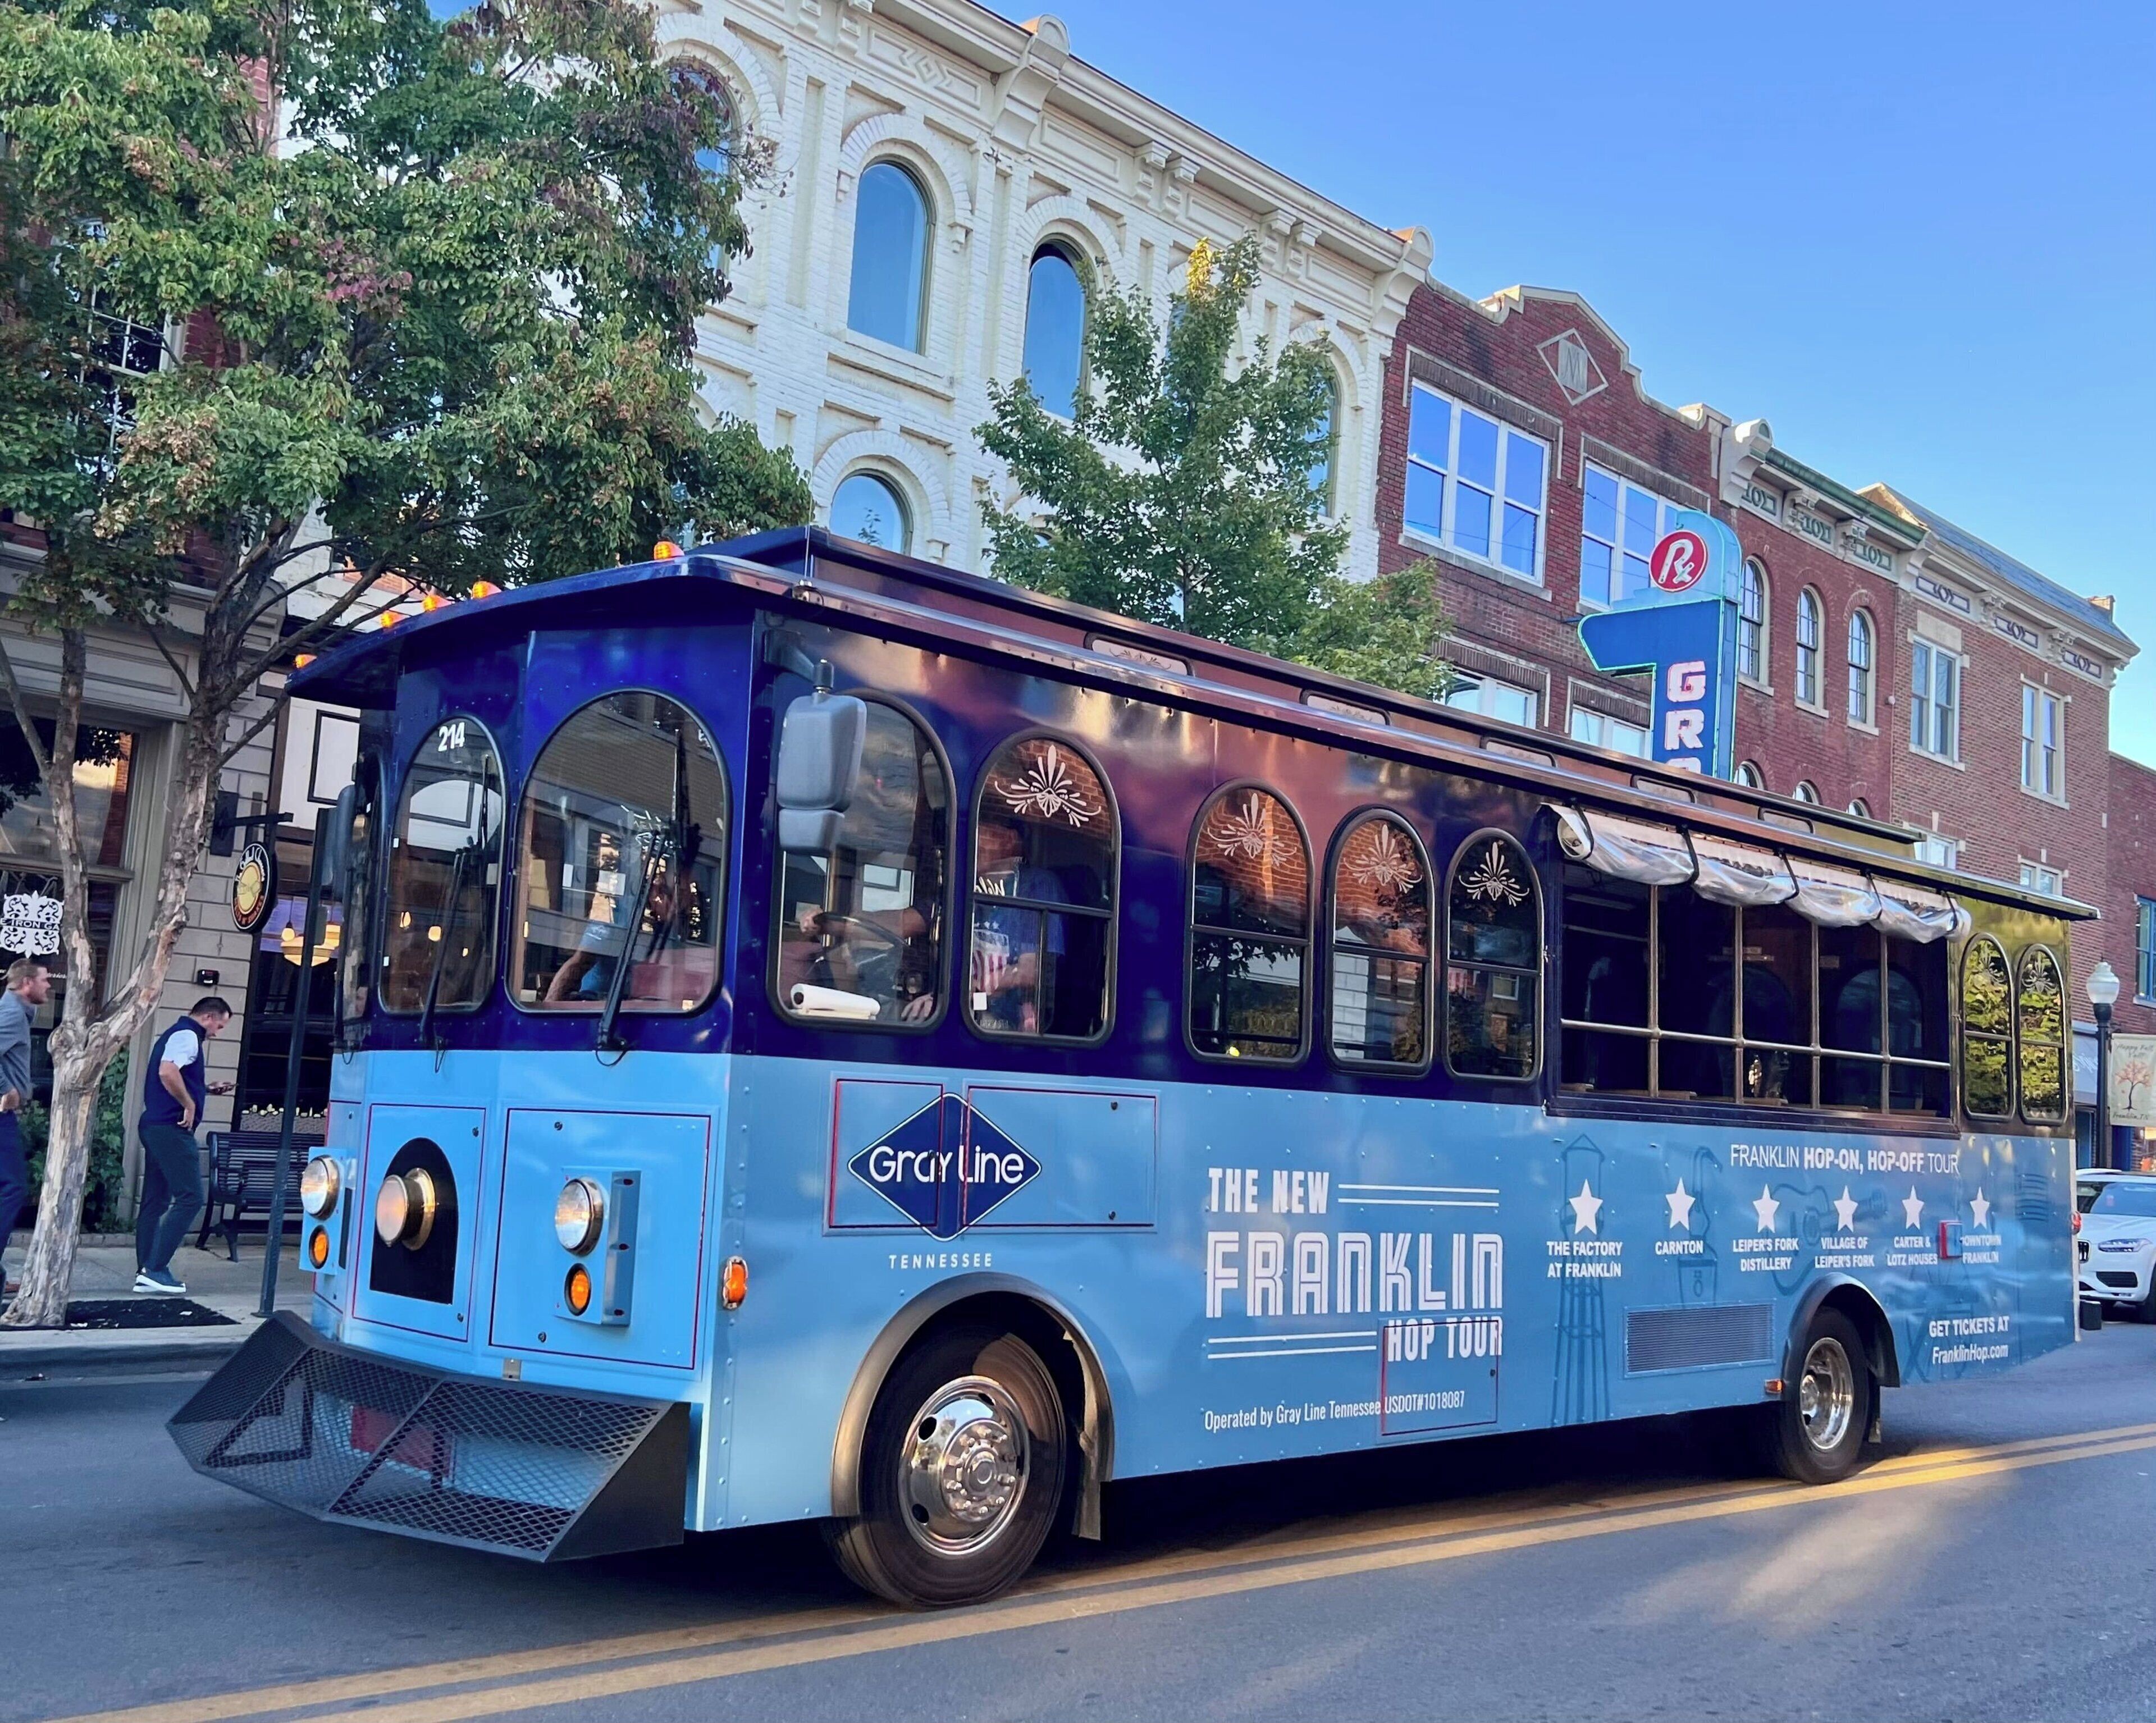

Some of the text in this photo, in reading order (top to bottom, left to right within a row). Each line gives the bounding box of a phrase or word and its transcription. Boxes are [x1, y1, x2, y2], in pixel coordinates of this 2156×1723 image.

[438, 721, 465, 752] 214
[11, 919, 40, 929] IRON
[869, 1145, 1024, 1184] Gray Line
[1730, 1144, 1959, 1174] FRANKLIN HOP-ON, HOP-OFF TOUR
[1209, 1168, 1330, 1214] THE NEW
[1546, 1241, 1623, 1256] THE FACTORY
[1655, 1240, 1703, 1255] CARNTON
[1733, 1238, 1799, 1253] LEIPER'S FORK
[1821, 1237, 1868, 1250] VILLAGE OF
[1894, 1236, 1931, 1249] CARTER &
[889, 1253, 992, 1269] TENNESSEE
[1741, 1257, 1792, 1272] DISTILLERY
[1815, 1255, 1875, 1269] LEIPER'S FORK
[1887, 1253, 1938, 1267] LOTZ HOUSES
[1962, 1251, 1999, 1264] FRANKLIN
[1205, 1231, 1503, 1318] FRANKLIN
[1547, 1262, 1621, 1278] AT FRANKLIN
[1929, 1315, 2009, 1337] GET TICKETS AT
[1388, 1316, 1502, 1362] HOP TOUR
[1933, 1343, 2008, 1364] FranklinHop.com
[1204, 1391, 1465, 1433] Operated by Gray Line Tennessee USDOT#1018087
